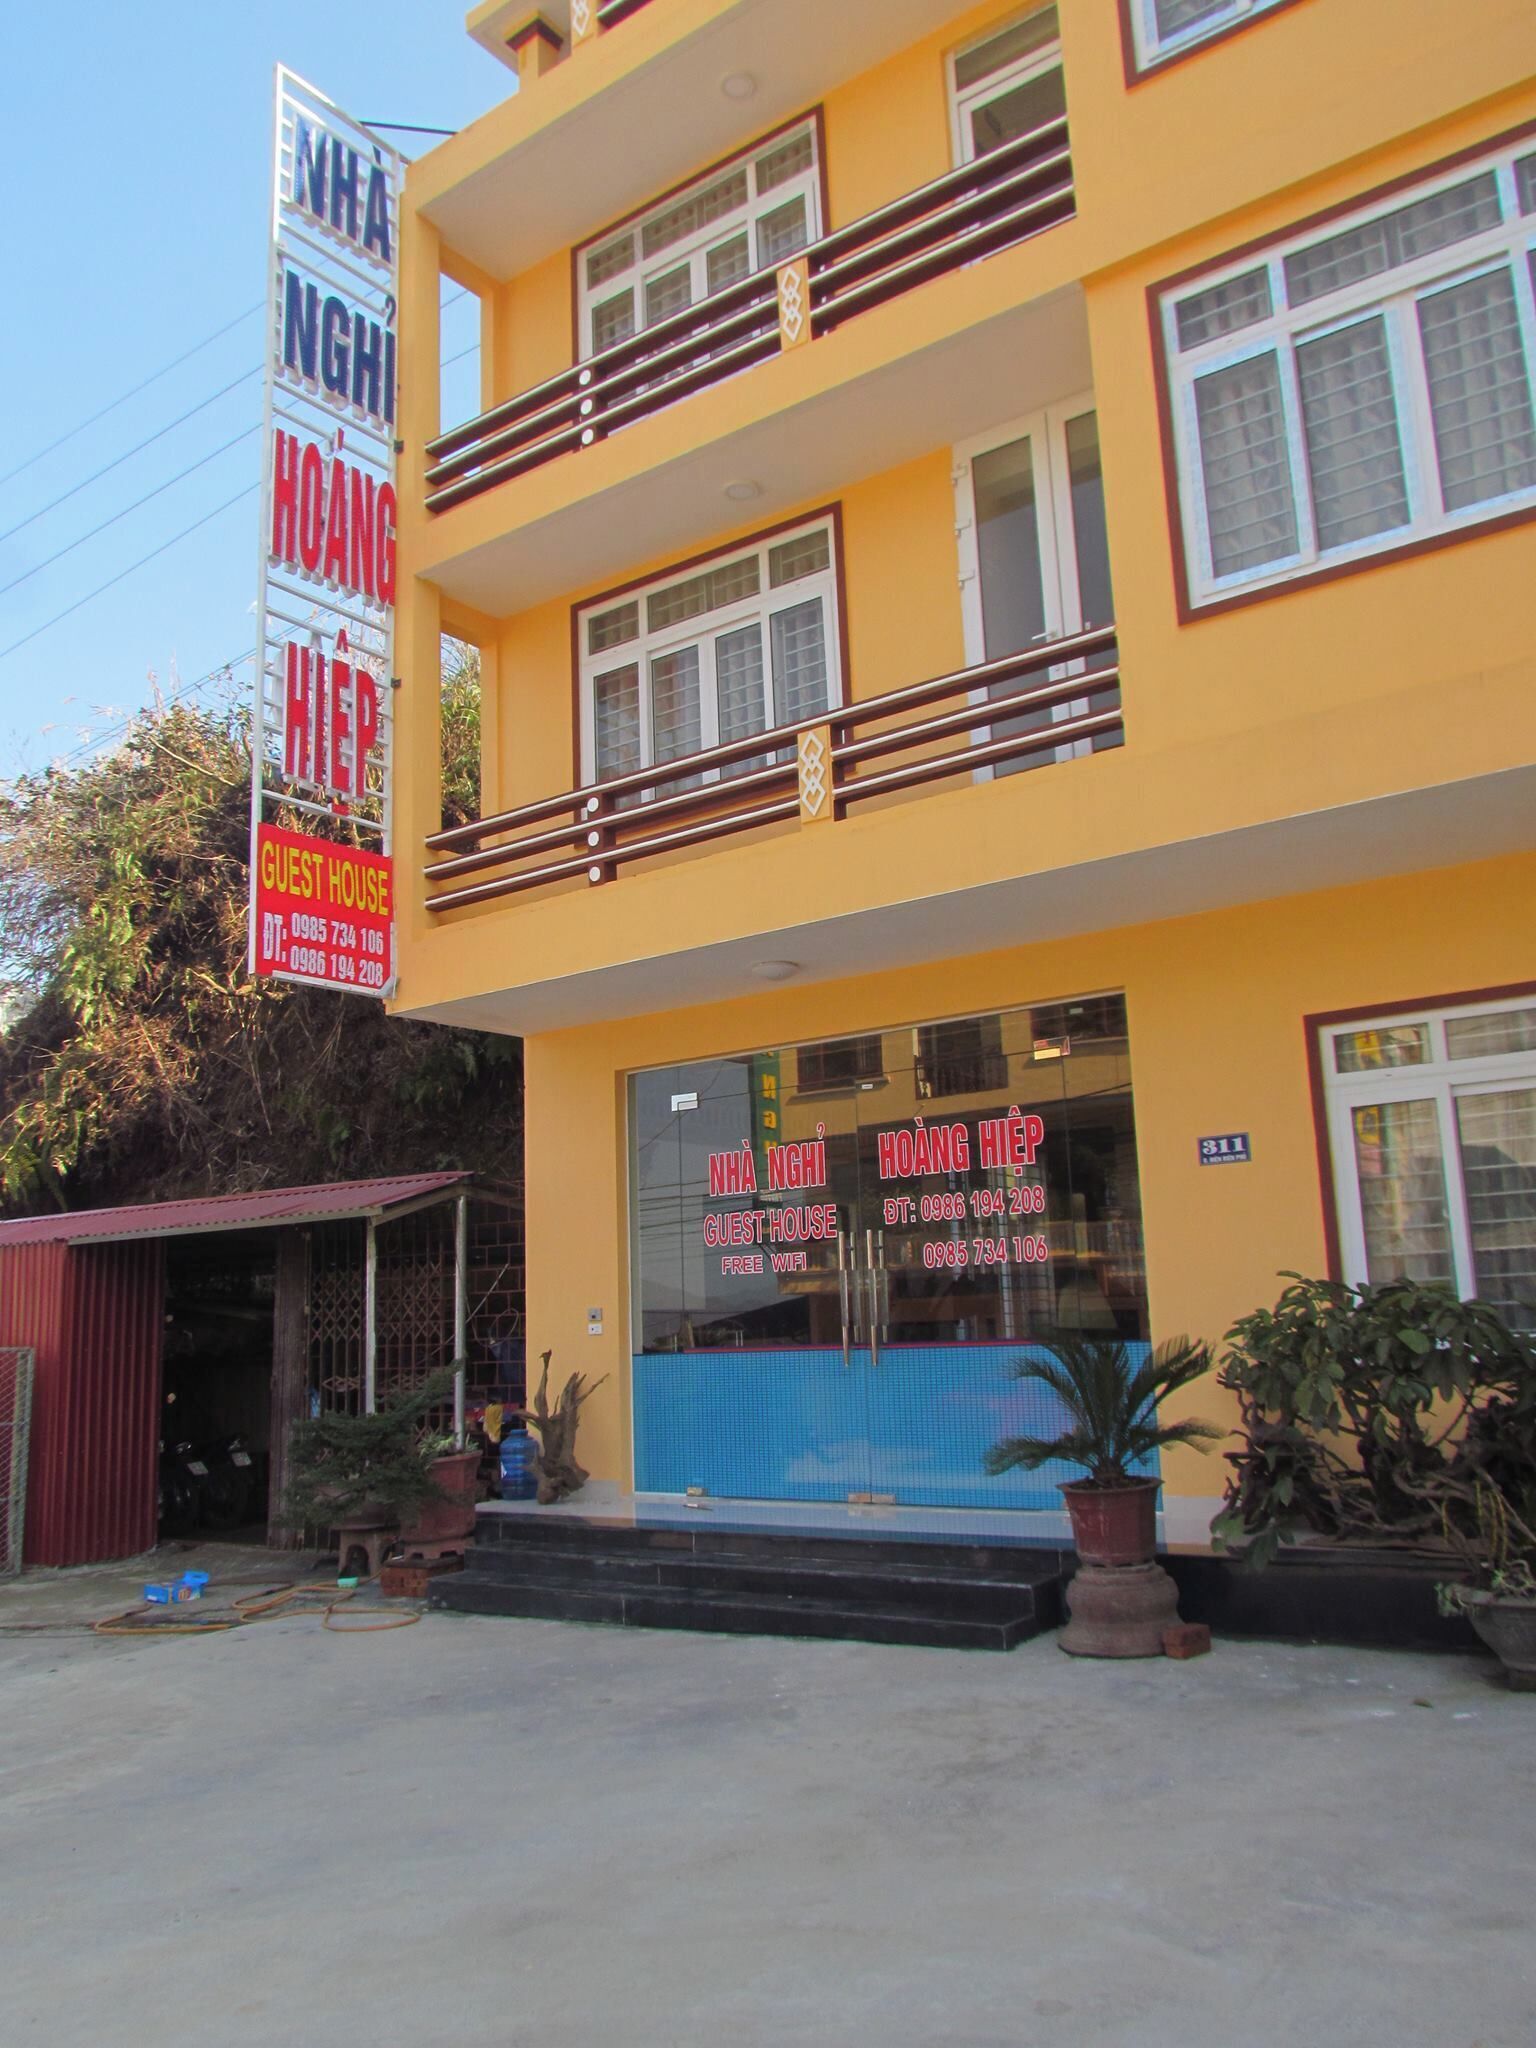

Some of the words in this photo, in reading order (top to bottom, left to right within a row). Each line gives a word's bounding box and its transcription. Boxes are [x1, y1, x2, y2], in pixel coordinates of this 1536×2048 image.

[293, 112, 391, 264] NHÀ
[284, 269, 396, 426] NGHỈ
[283, 629, 377, 817] HIỆP
[261, 840, 323, 900] GUEST
[329, 857, 389, 916] HOUSE
[291, 913, 327, 943] 0985
[331, 921, 357, 948] 734
[360, 927, 384, 955] 106
[290, 945, 326, 976] 0986
[330, 954, 355, 980] 194
[358, 959, 383, 986] 208
[709, 1139, 757, 1197] NHÀ
[768, 1122, 826, 1190] NGHỈ
[878, 1117, 970, 1179] HOÀNG
[979, 1105, 1044, 1176] HIỆP
[1202, 1137, 1246, 1155] 311
[704, 1211, 765, 1247] GUEST
[769, 1204, 838, 1242] HOUSE
[884, 1197, 916, 1225] ĐT:
[921, 1192, 965, 1221] 0986
[970, 1188, 1005, 1218] 194
[1009, 1185, 1045, 1214] 208
[722, 1255, 763, 1275] FREE
[771, 1252, 807, 1272] WIFI
[923, 1240, 968, 1268] 0985
[973, 1237, 1007, 1265] 734
[1012, 1235, 1048, 1262] 106
